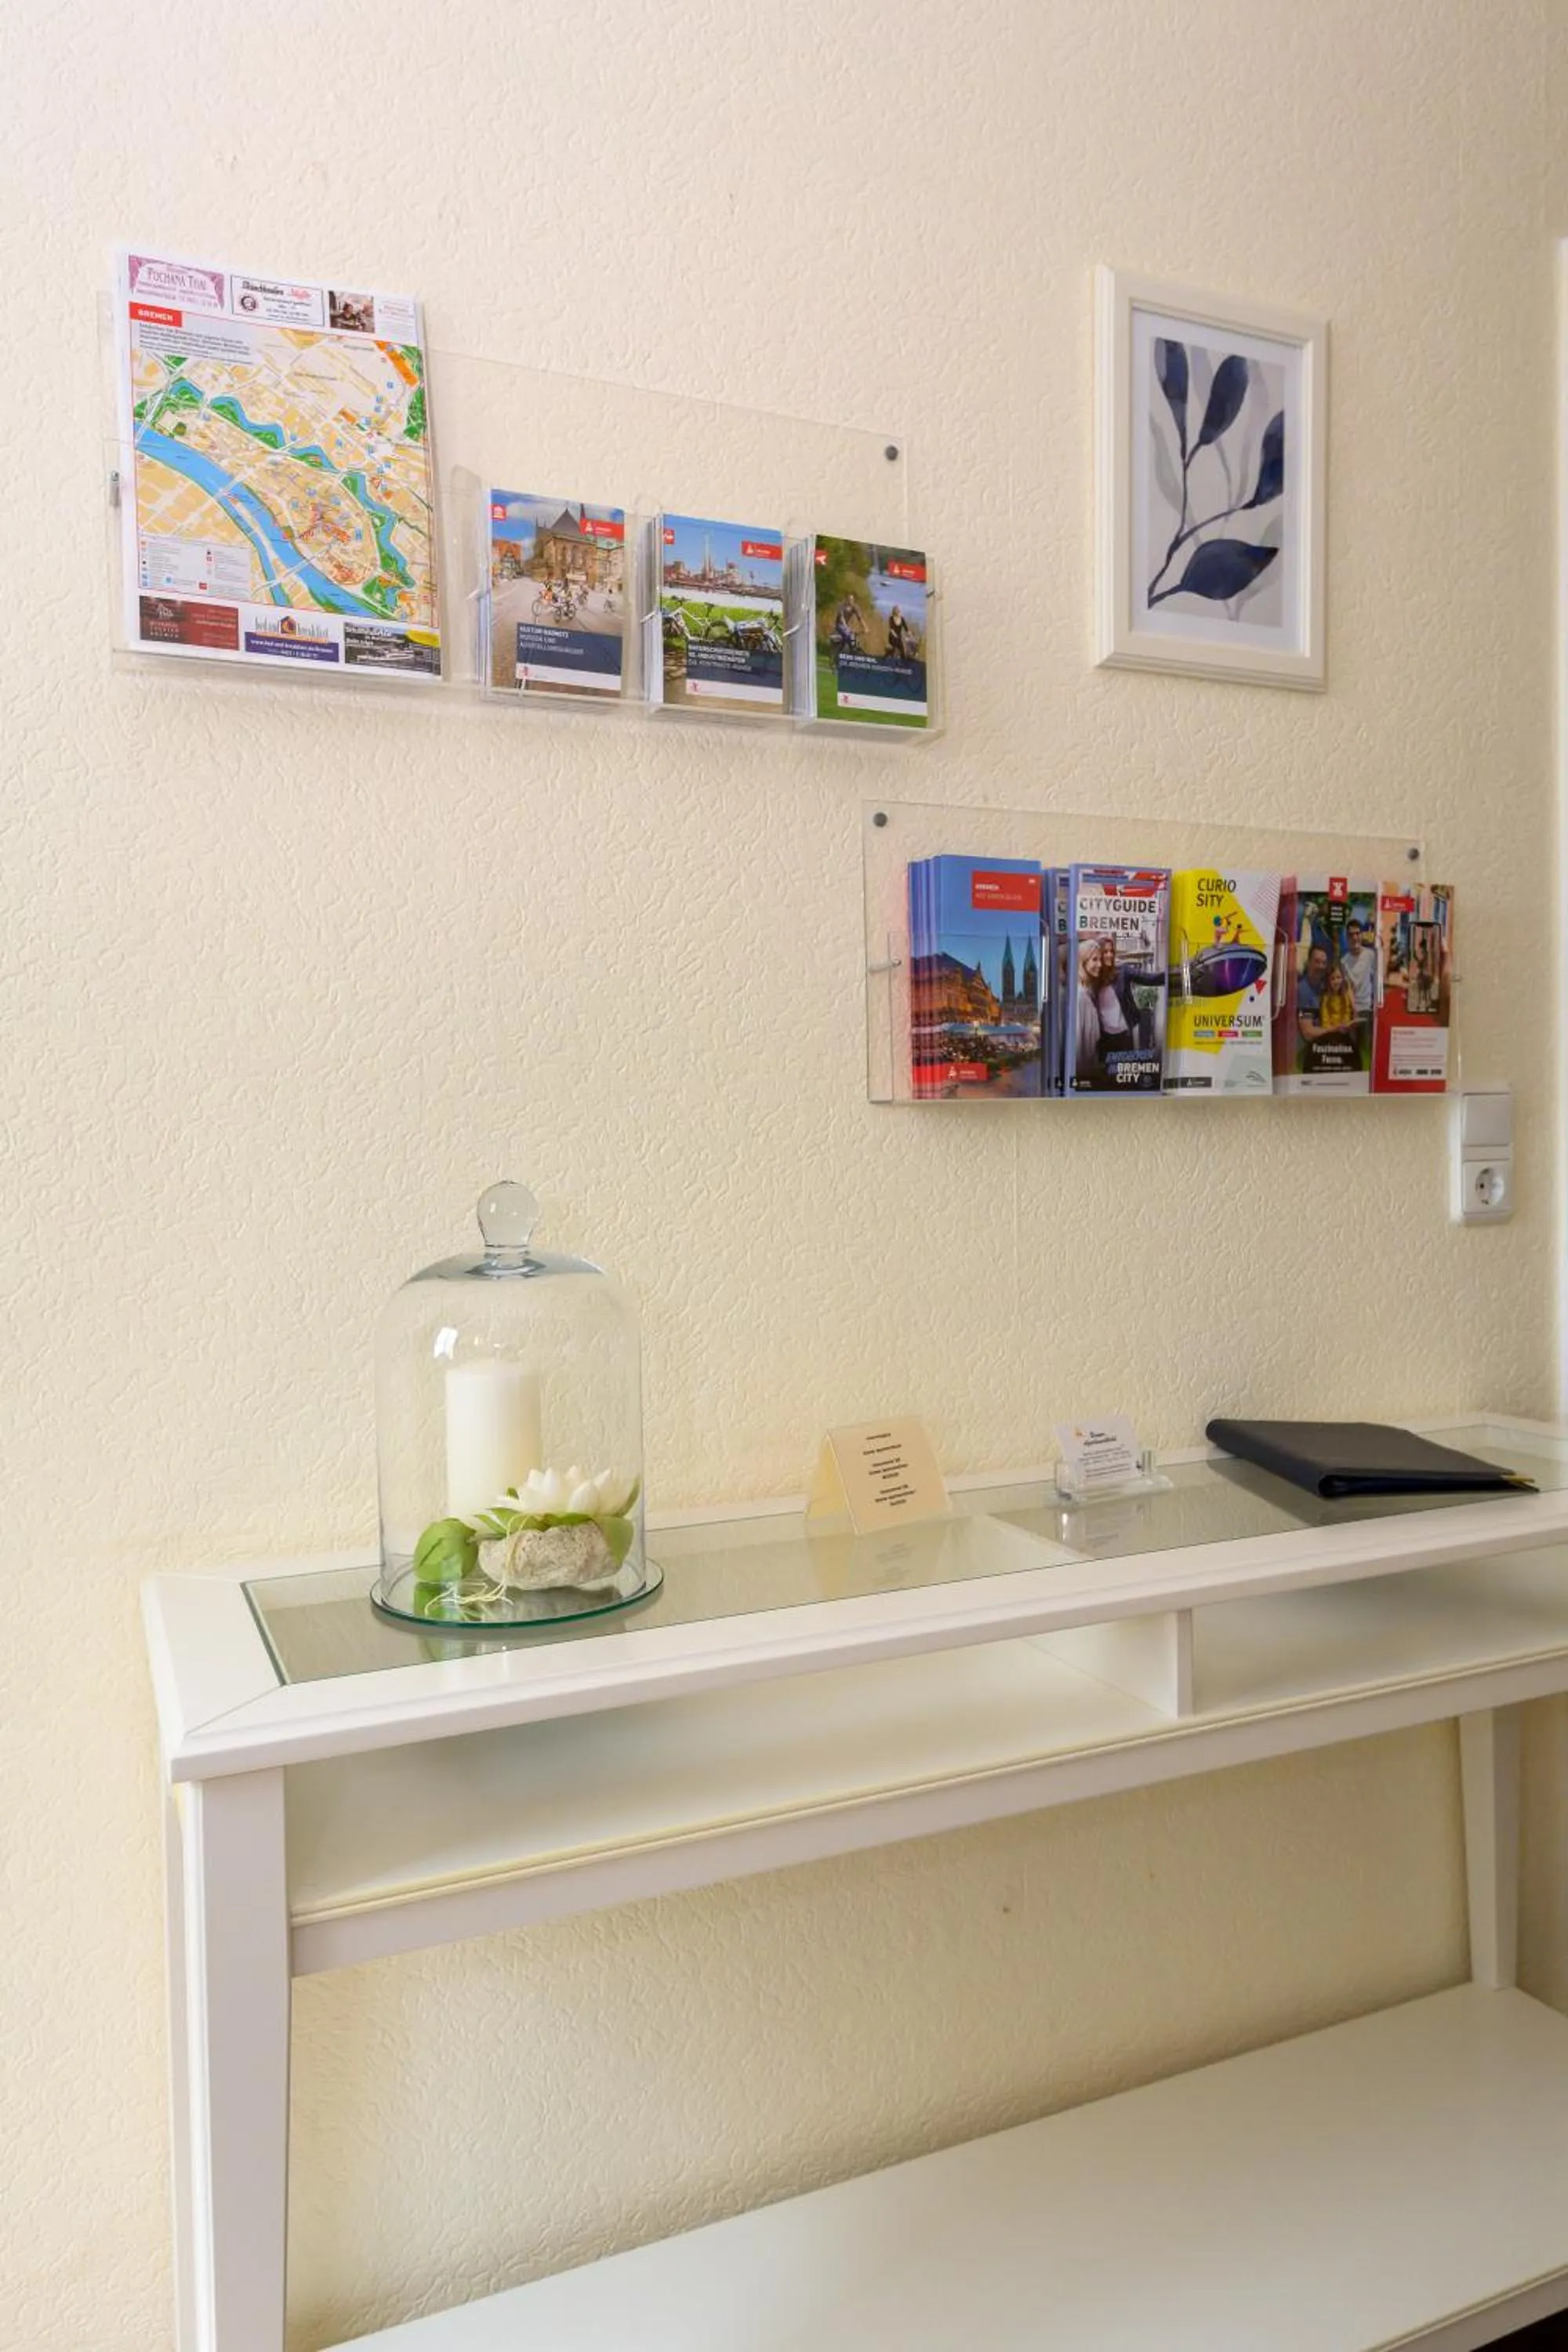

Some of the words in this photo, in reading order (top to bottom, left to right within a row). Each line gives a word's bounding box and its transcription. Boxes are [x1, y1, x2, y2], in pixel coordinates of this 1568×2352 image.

[137, 309, 174, 321] BREMEN
[1197, 877, 1236, 892] CURIO
[1080, 898, 1156, 913] CITYGUIDE
[1196, 893, 1223, 907] SITY
[1080, 916, 1139, 931] BREMEN
[1194, 1015, 1262, 1028] UNIVERSUM
[1117, 1062, 1160, 1073] BREMEN
[1116, 1073, 1140, 1083] CITY
